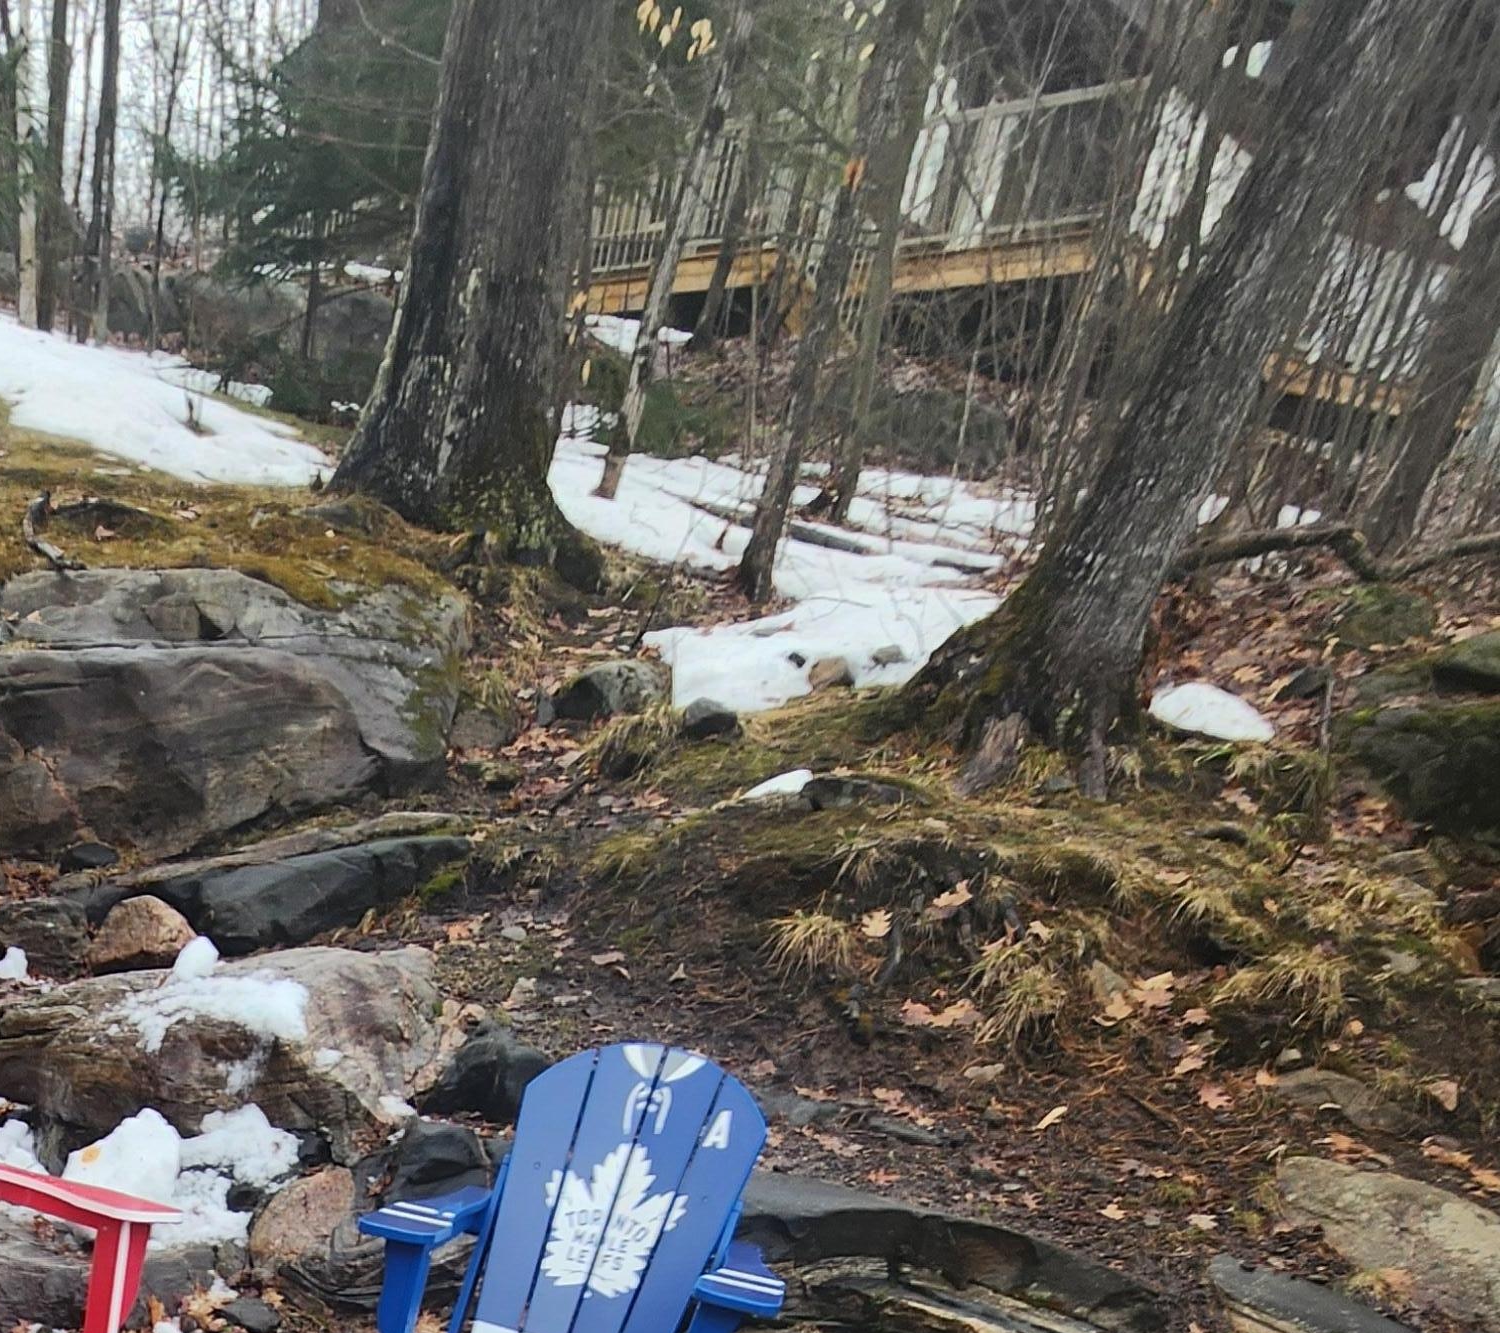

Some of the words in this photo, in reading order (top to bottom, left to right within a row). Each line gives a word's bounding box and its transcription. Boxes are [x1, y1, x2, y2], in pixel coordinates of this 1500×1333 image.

[701, 1109, 733, 1149] A
[565, 1209, 648, 1242] TORNTO
[573, 1229, 627, 1253] MALE
[566, 1246, 625, 1271] LEFS
